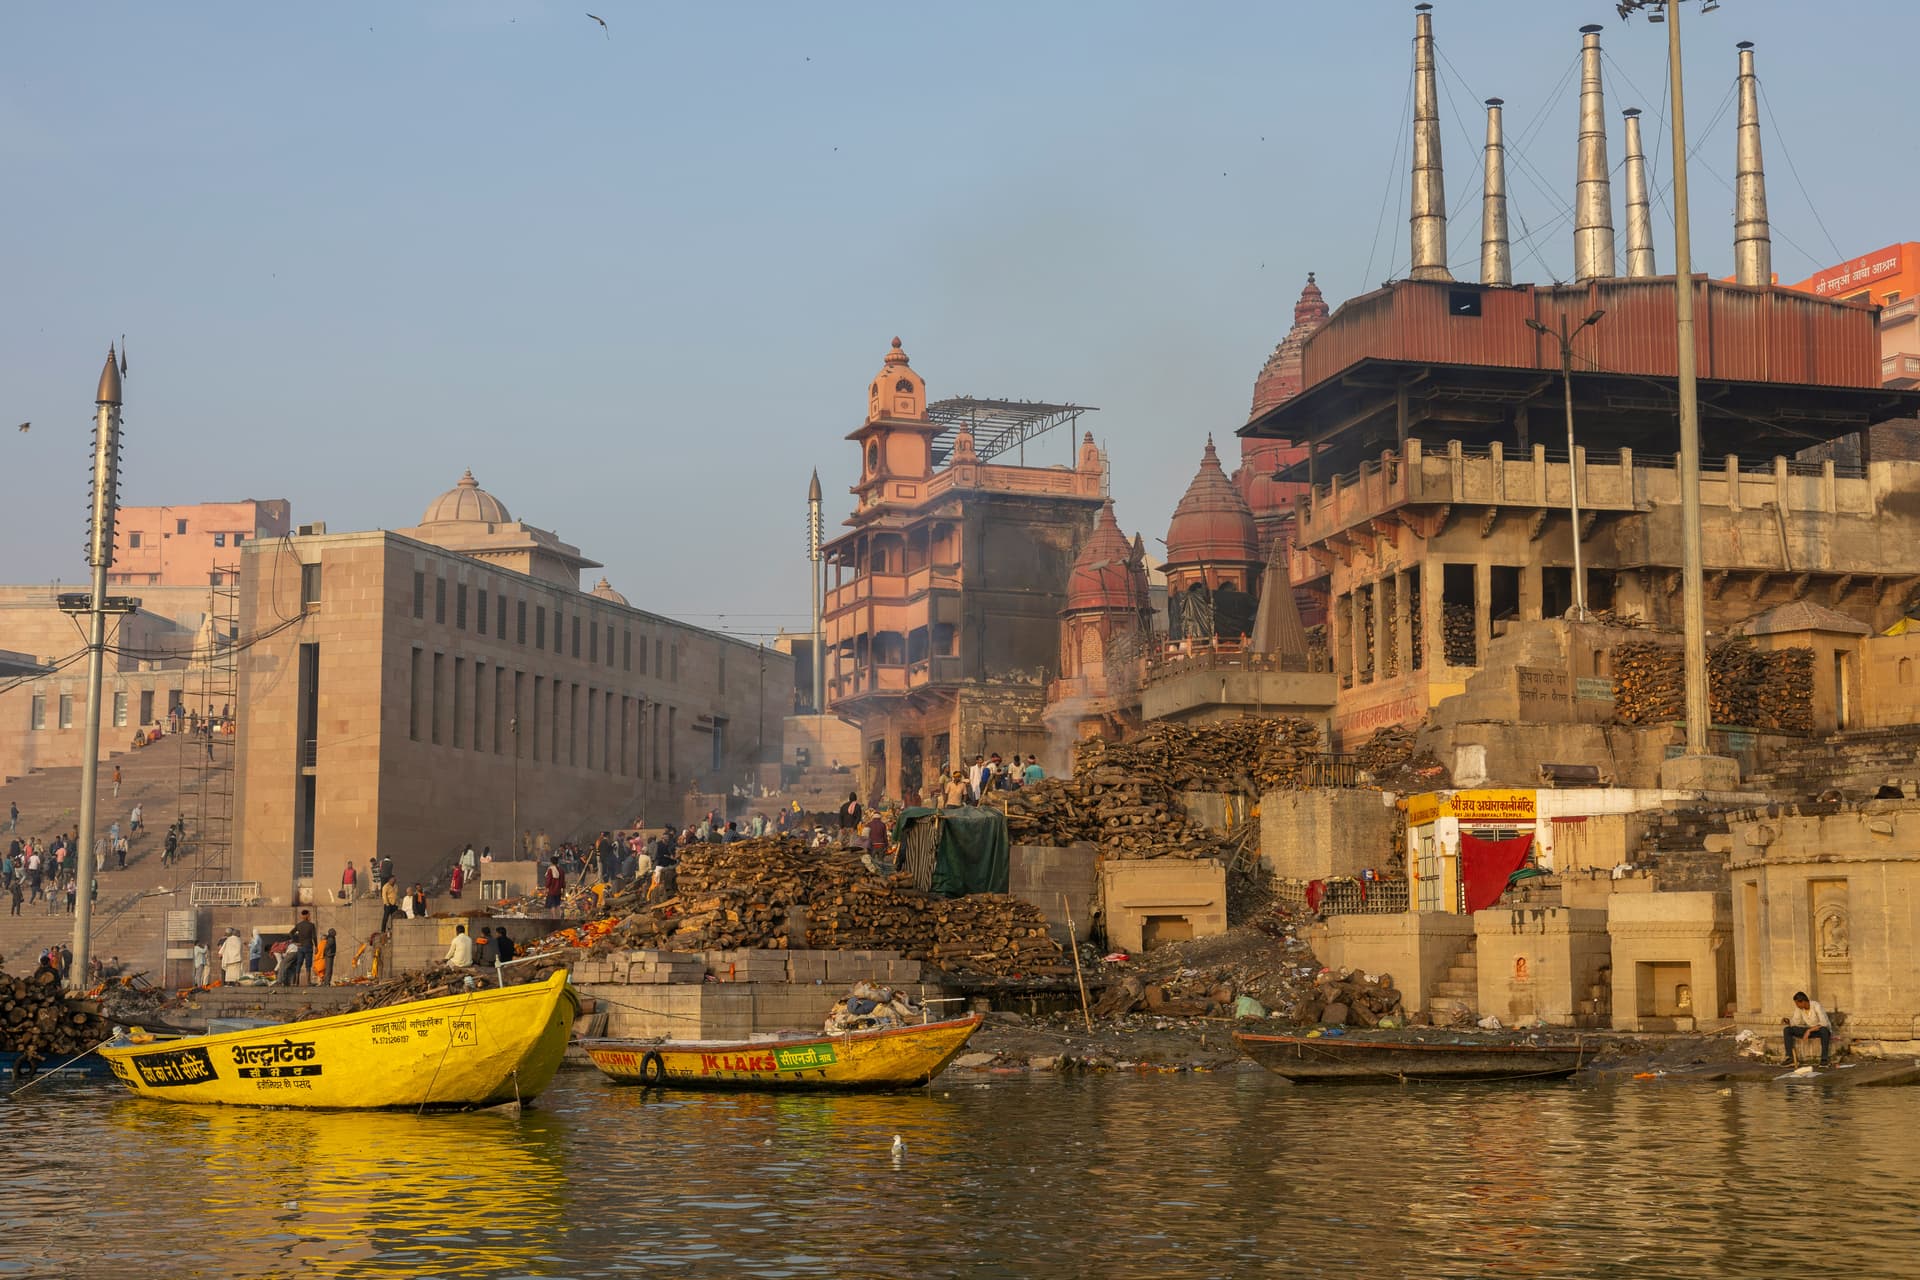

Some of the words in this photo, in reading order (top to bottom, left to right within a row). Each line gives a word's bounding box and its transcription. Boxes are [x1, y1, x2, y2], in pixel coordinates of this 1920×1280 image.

[1815, 278, 1826, 295] श्री
[1872, 257, 1897, 274] आश्रम
[1450, 794, 1461, 811] श्री
[1462, 800, 1475, 811] जय
[457, 1031, 469, 1043] 40
[231, 1038, 316, 1067] अल्ट्राटेक
[778, 1048, 818, 1066] सीएनजी
[701, 1054, 721, 1075] JK
[723, 1055, 777, 1071] LAKS
[153, 1066, 169, 1082] का
